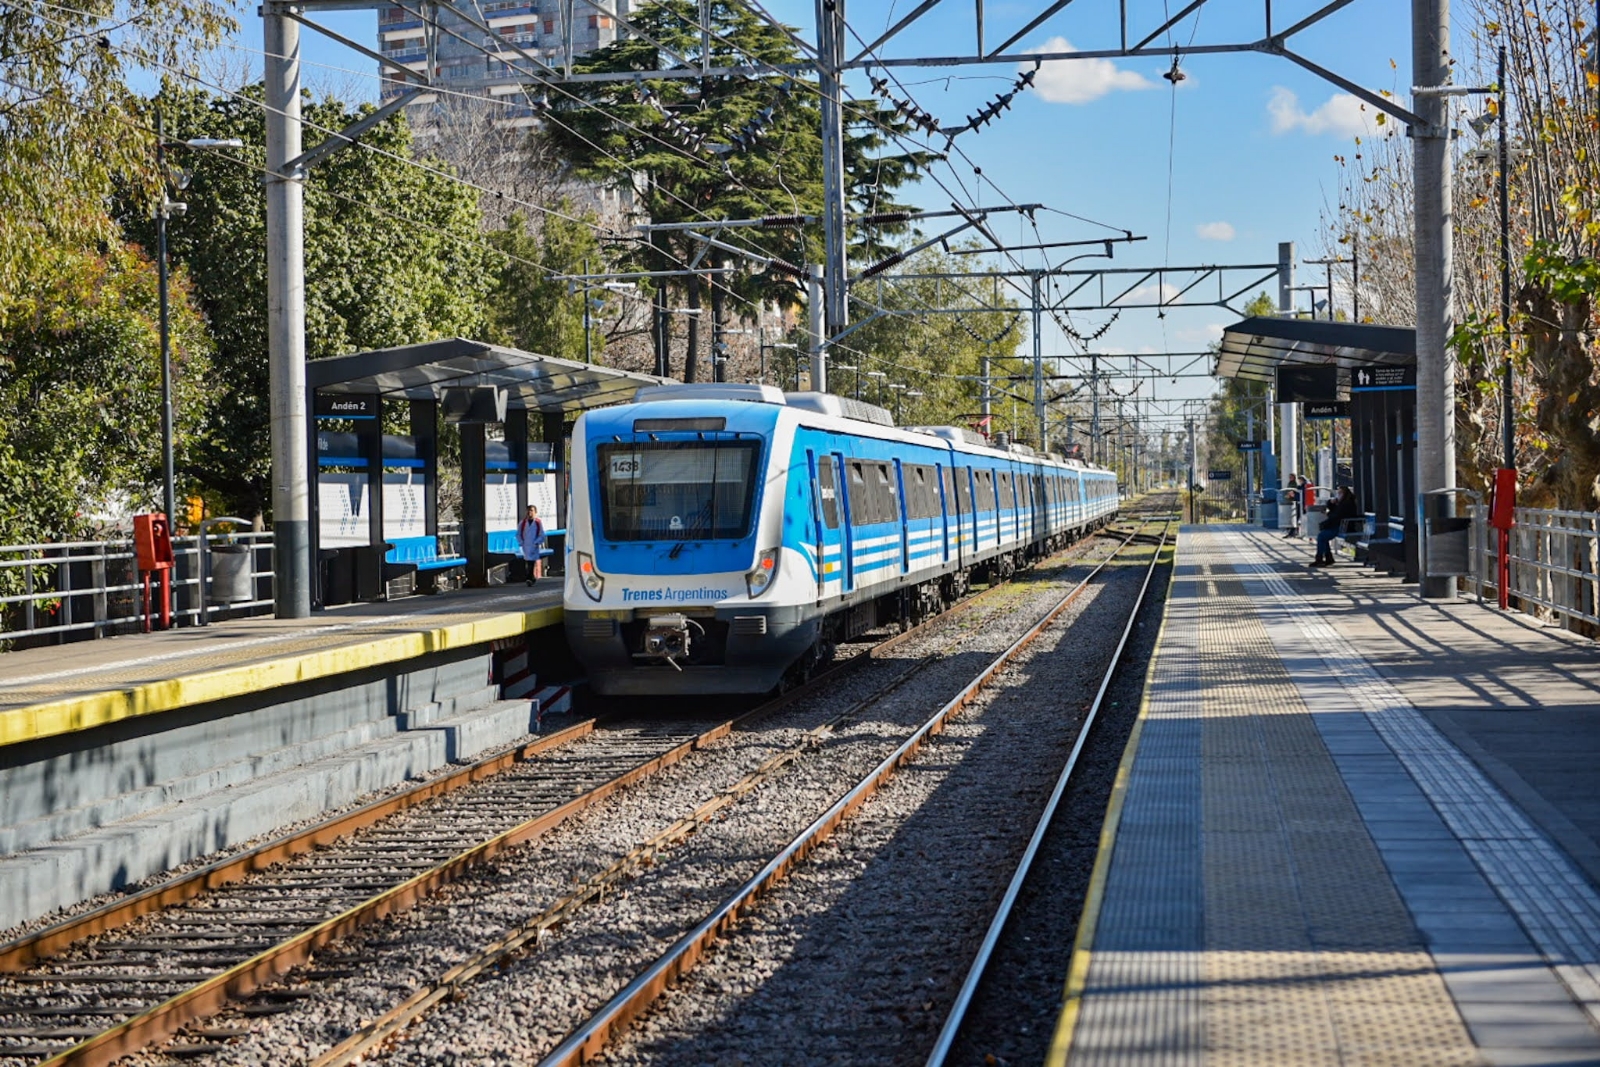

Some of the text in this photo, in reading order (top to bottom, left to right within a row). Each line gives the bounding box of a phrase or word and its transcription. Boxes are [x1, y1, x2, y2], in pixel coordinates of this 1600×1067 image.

[331, 401, 366, 410] Andén 2
[621, 586, 728, 602] Trenes Argentinos
